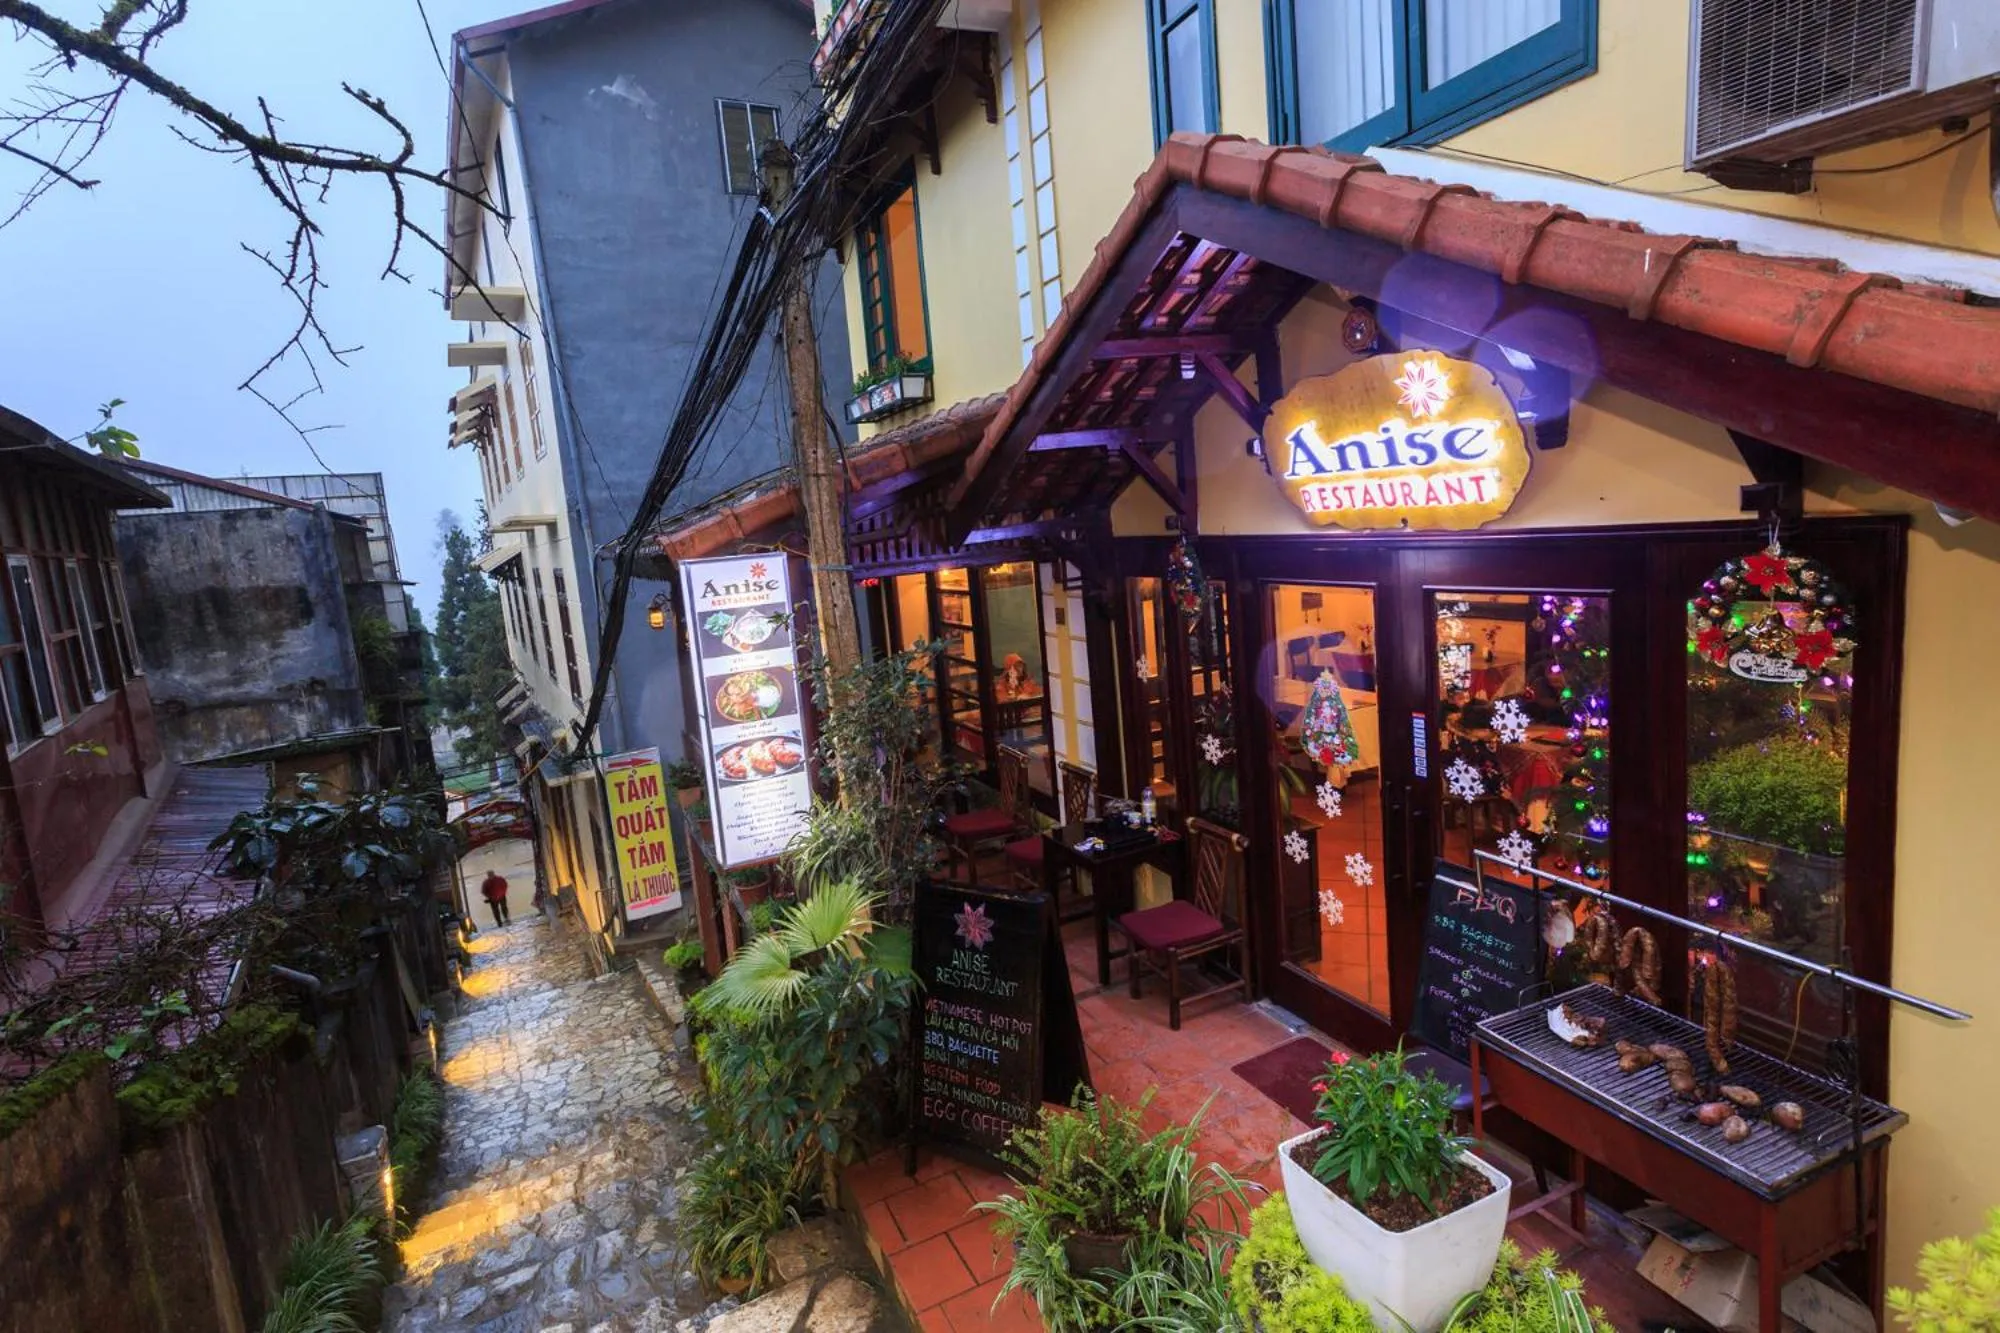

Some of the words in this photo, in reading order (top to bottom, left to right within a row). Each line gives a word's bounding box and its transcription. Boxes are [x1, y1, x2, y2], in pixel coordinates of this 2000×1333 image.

[1286, 426, 1490, 478] Anise
[1301, 475, 1489, 512] RESTAURANT
[700, 578, 781, 598] Anise
[616, 801, 667, 840] QUẤT
[627, 837, 667, 869] TẮM
[626, 875, 642, 904] LÁ
[642, 865, 676, 900] THUỐC
[951, 948, 991, 975] ANISE
[936, 966, 1019, 997] RESTAURANT
[924, 997, 984, 1025] VIETNAMESE
[924, 1029, 945, 1049] BBQ
[948, 1036, 1001, 1065] BAGUETTE
[922, 1078, 949, 1096] SAPA
[952, 1086, 998, 1111] MINORITY
[923, 1061, 969, 1085] WESTERN
[975, 1076, 1001, 1096] FOOD
[923, 1096, 956, 1121] EGG
[960, 1108, 1012, 1141] COFFE
